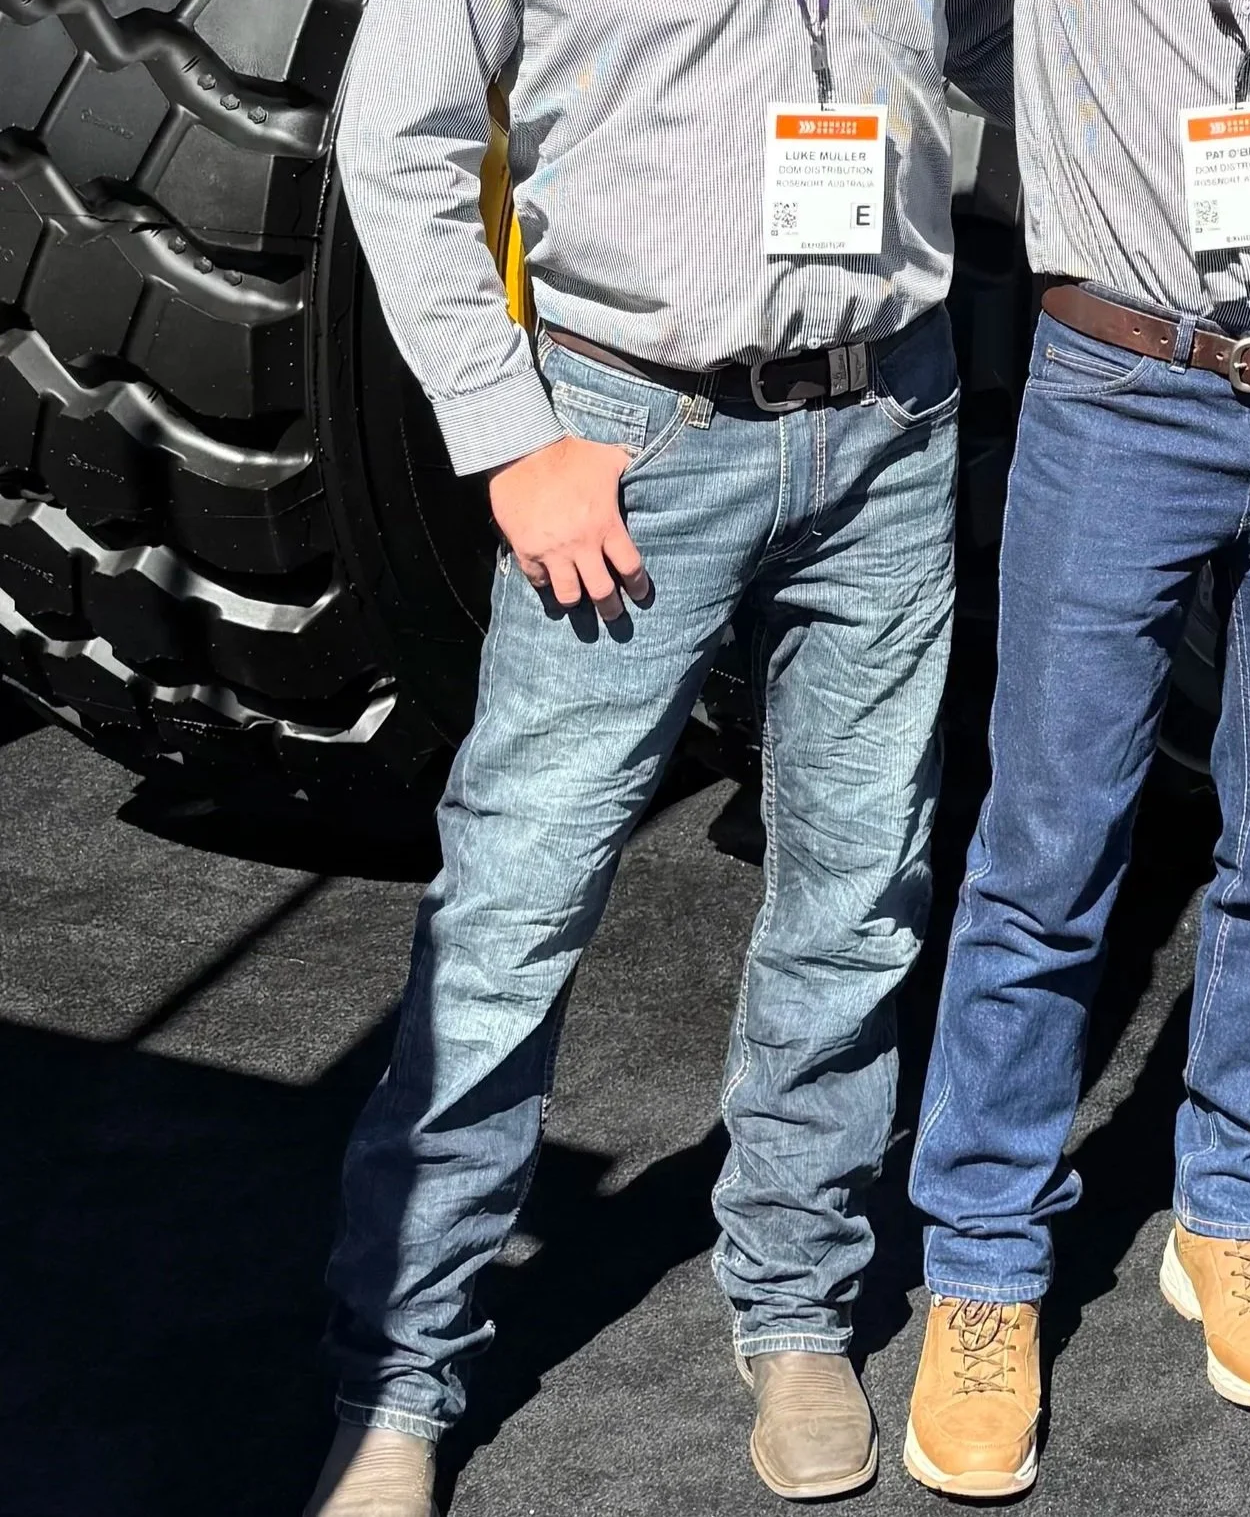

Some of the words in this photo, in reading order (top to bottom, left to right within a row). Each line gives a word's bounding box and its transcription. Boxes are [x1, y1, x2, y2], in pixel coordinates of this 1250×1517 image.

[785, 151, 816, 161] LUKE
[820, 152, 866, 161] MULLER
[1206, 150, 1224, 160] PAT
[779, 165, 802, 174] DOM
[804, 166, 873, 175] DISTRIBUTION
[1195, 165, 1218, 174] DOM
[856, 205, 870, 226] E
